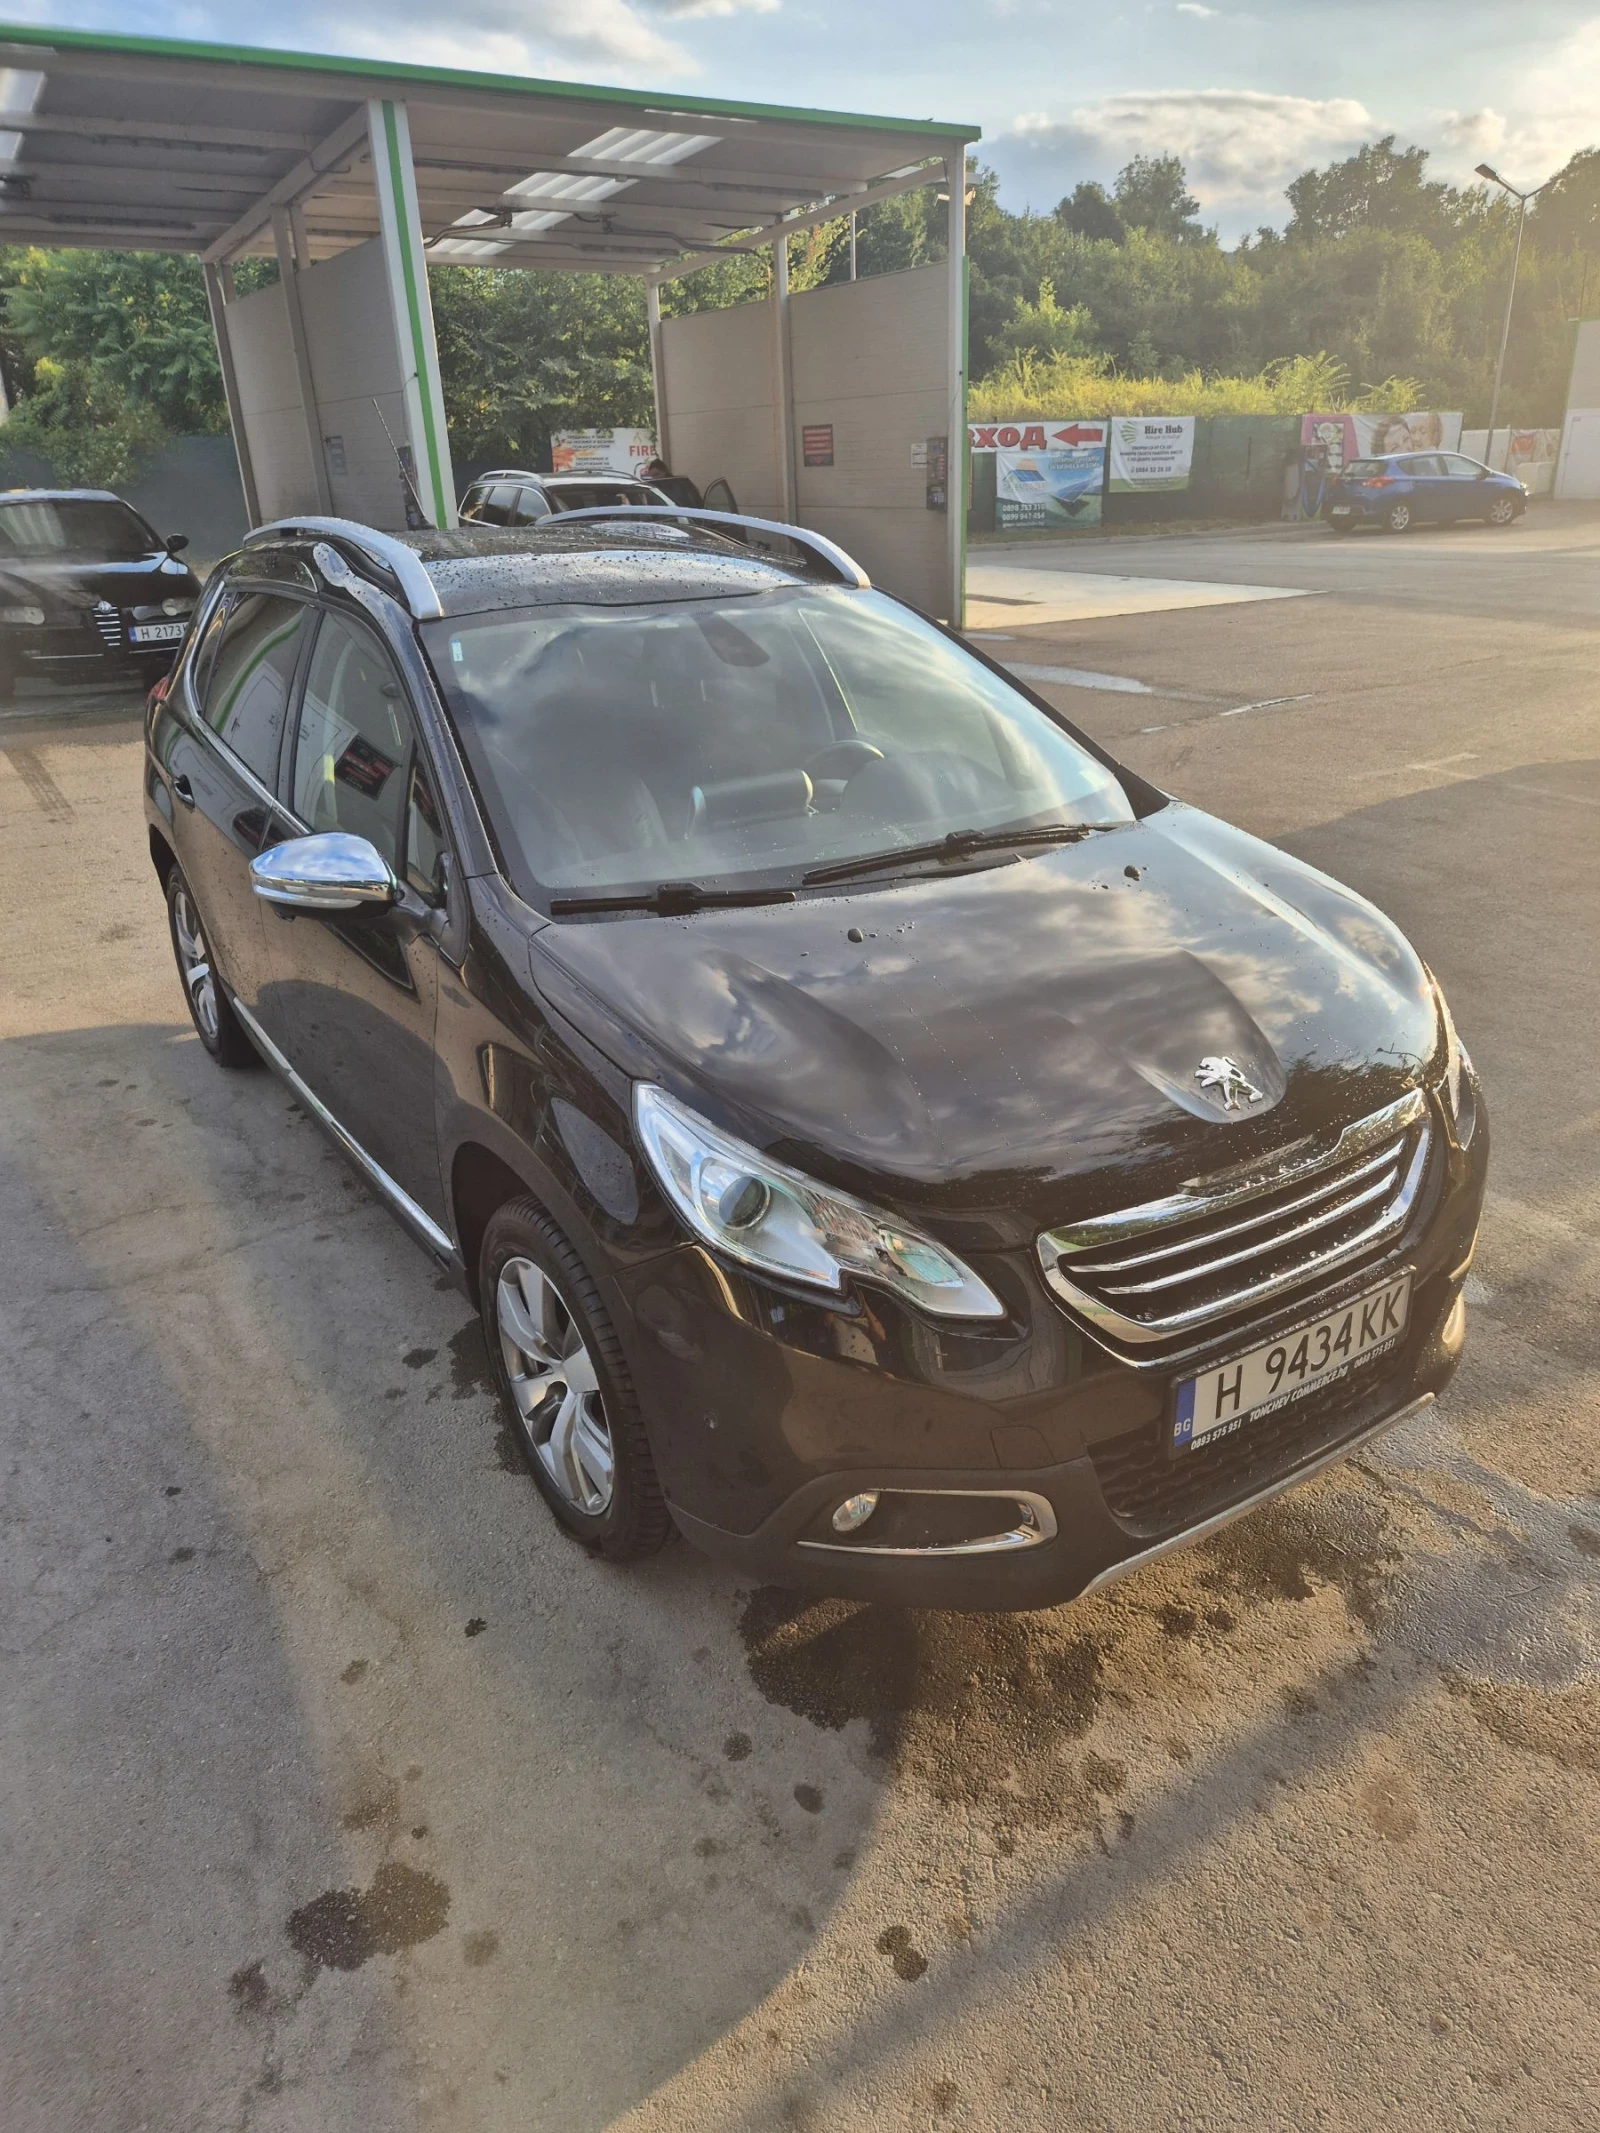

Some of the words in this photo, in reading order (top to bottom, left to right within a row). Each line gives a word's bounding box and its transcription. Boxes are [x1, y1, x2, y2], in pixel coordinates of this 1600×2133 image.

[1145, 425, 1163, 435] Hire
[1165, 424, 1183, 434] Hub
[629, 445, 655, 456] FIRE
[141, 629, 150, 639] H
[1215, 1364, 1243, 1420] H
[1211, 1425, 1228, 1441] 575
[1227, 1418, 1242, 1433] 951
[1250, 1395, 1290, 1422] TONCHEV
[1173, 1418, 1192, 1437] BG
